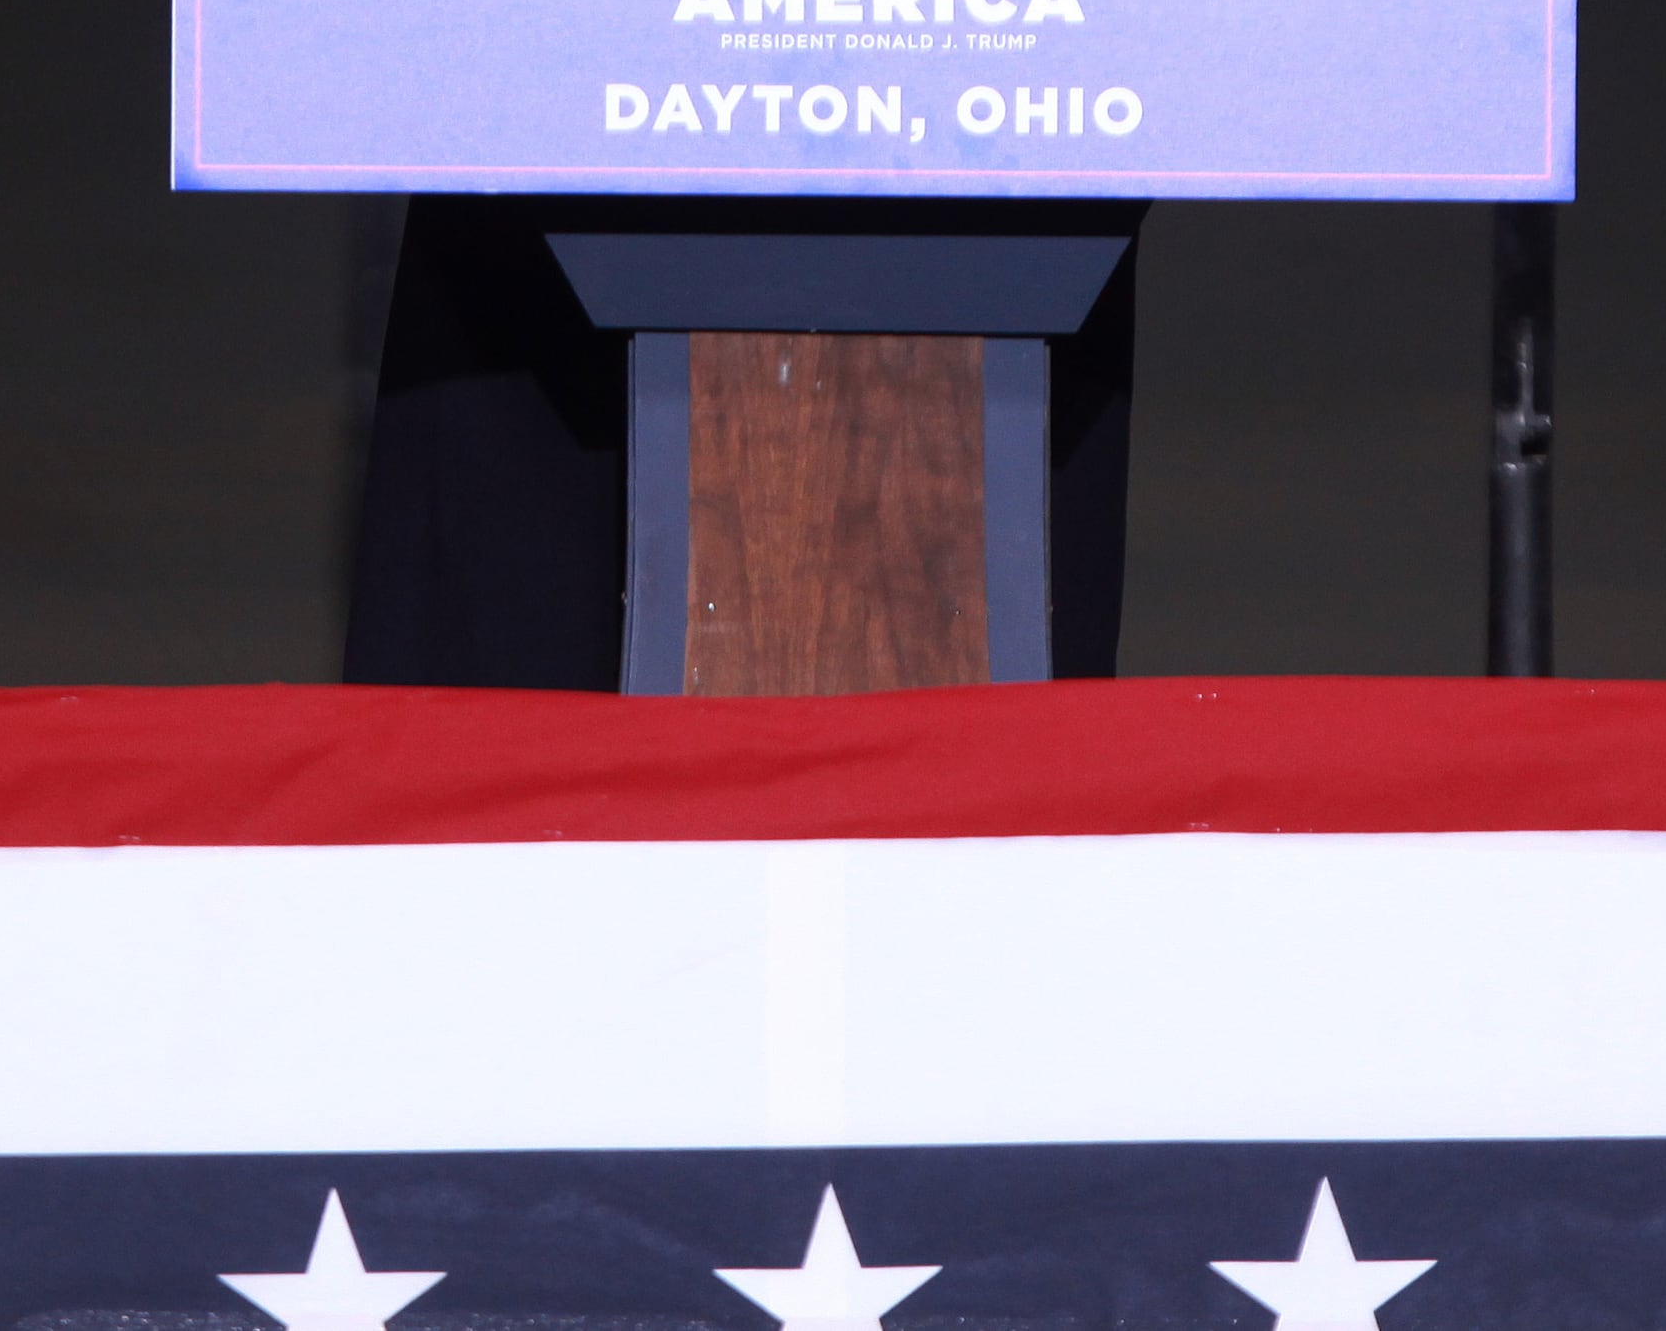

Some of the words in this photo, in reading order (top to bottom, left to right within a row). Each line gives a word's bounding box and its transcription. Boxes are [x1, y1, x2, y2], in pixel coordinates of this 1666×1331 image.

[720, 33, 838, 50] PRESIDENT
[844, 33, 934, 50] DONALD
[941, 33, 958, 50] J.
[966, 33, 1037, 50] TRUMP
[604, 83, 926, 142] DAYTON,
[956, 85, 1144, 136] OHIO
